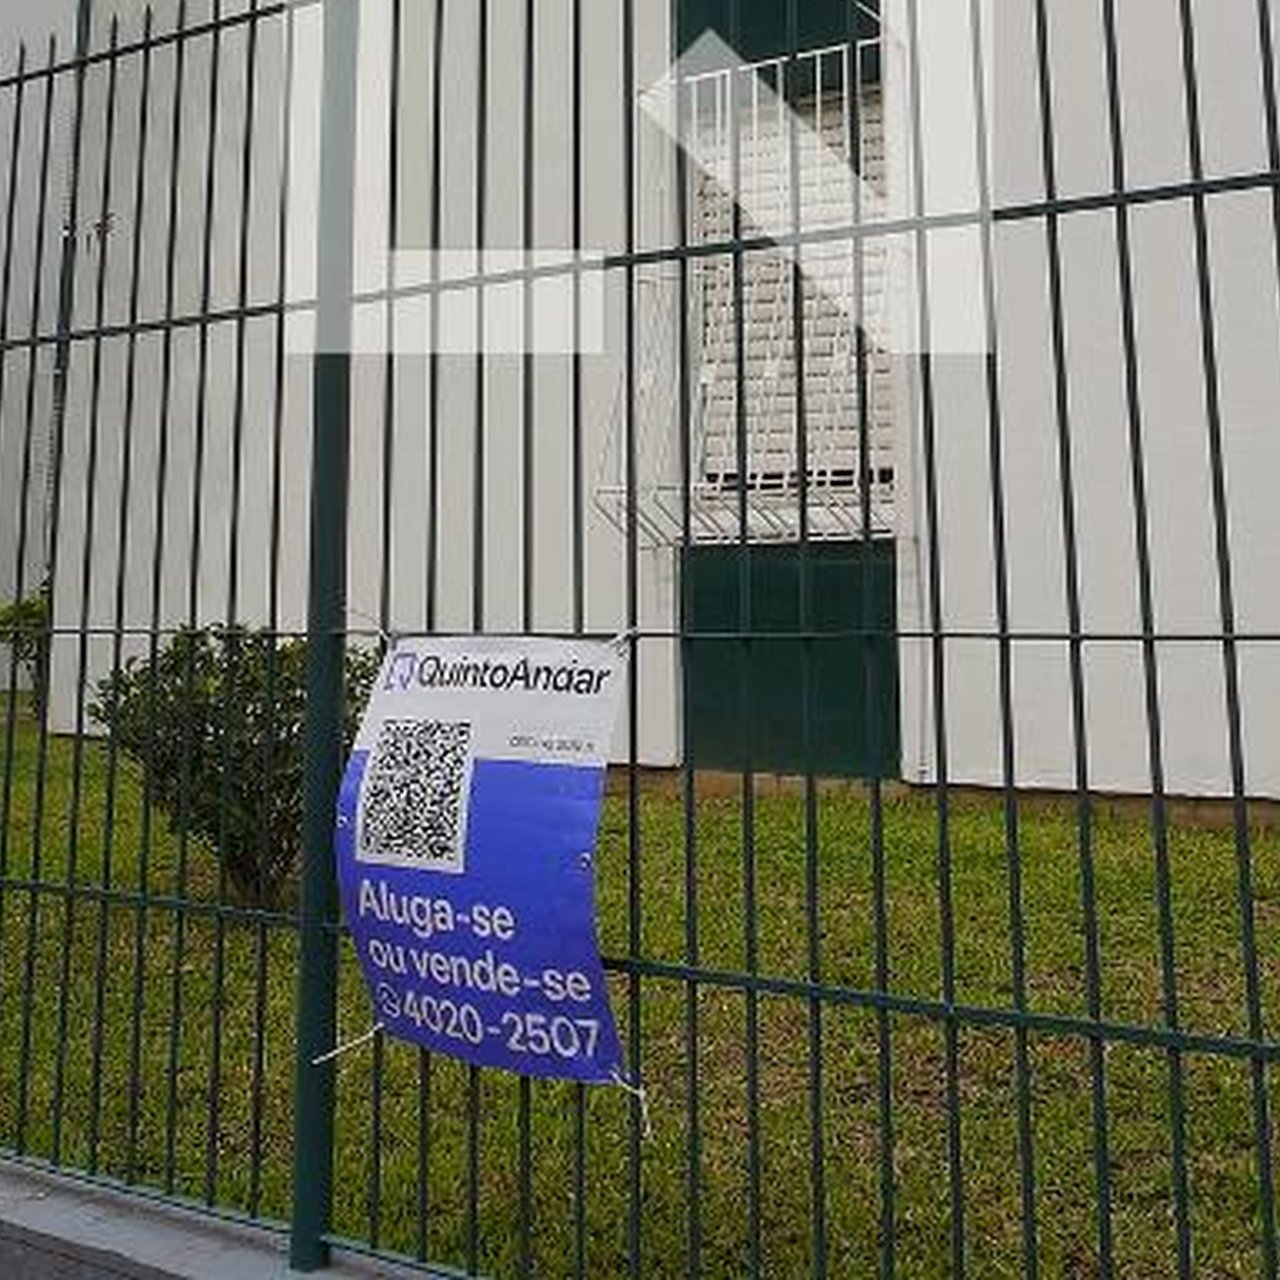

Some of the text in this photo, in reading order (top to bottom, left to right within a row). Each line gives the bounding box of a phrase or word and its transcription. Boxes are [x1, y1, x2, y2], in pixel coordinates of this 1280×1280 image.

[418, 655, 611, 695] QuintoAndar
[358, 878, 516, 940] Aluga-se
[368, 939, 592, 1003] ou vende-se
[404, 990, 601, 1059] 4020-2507
